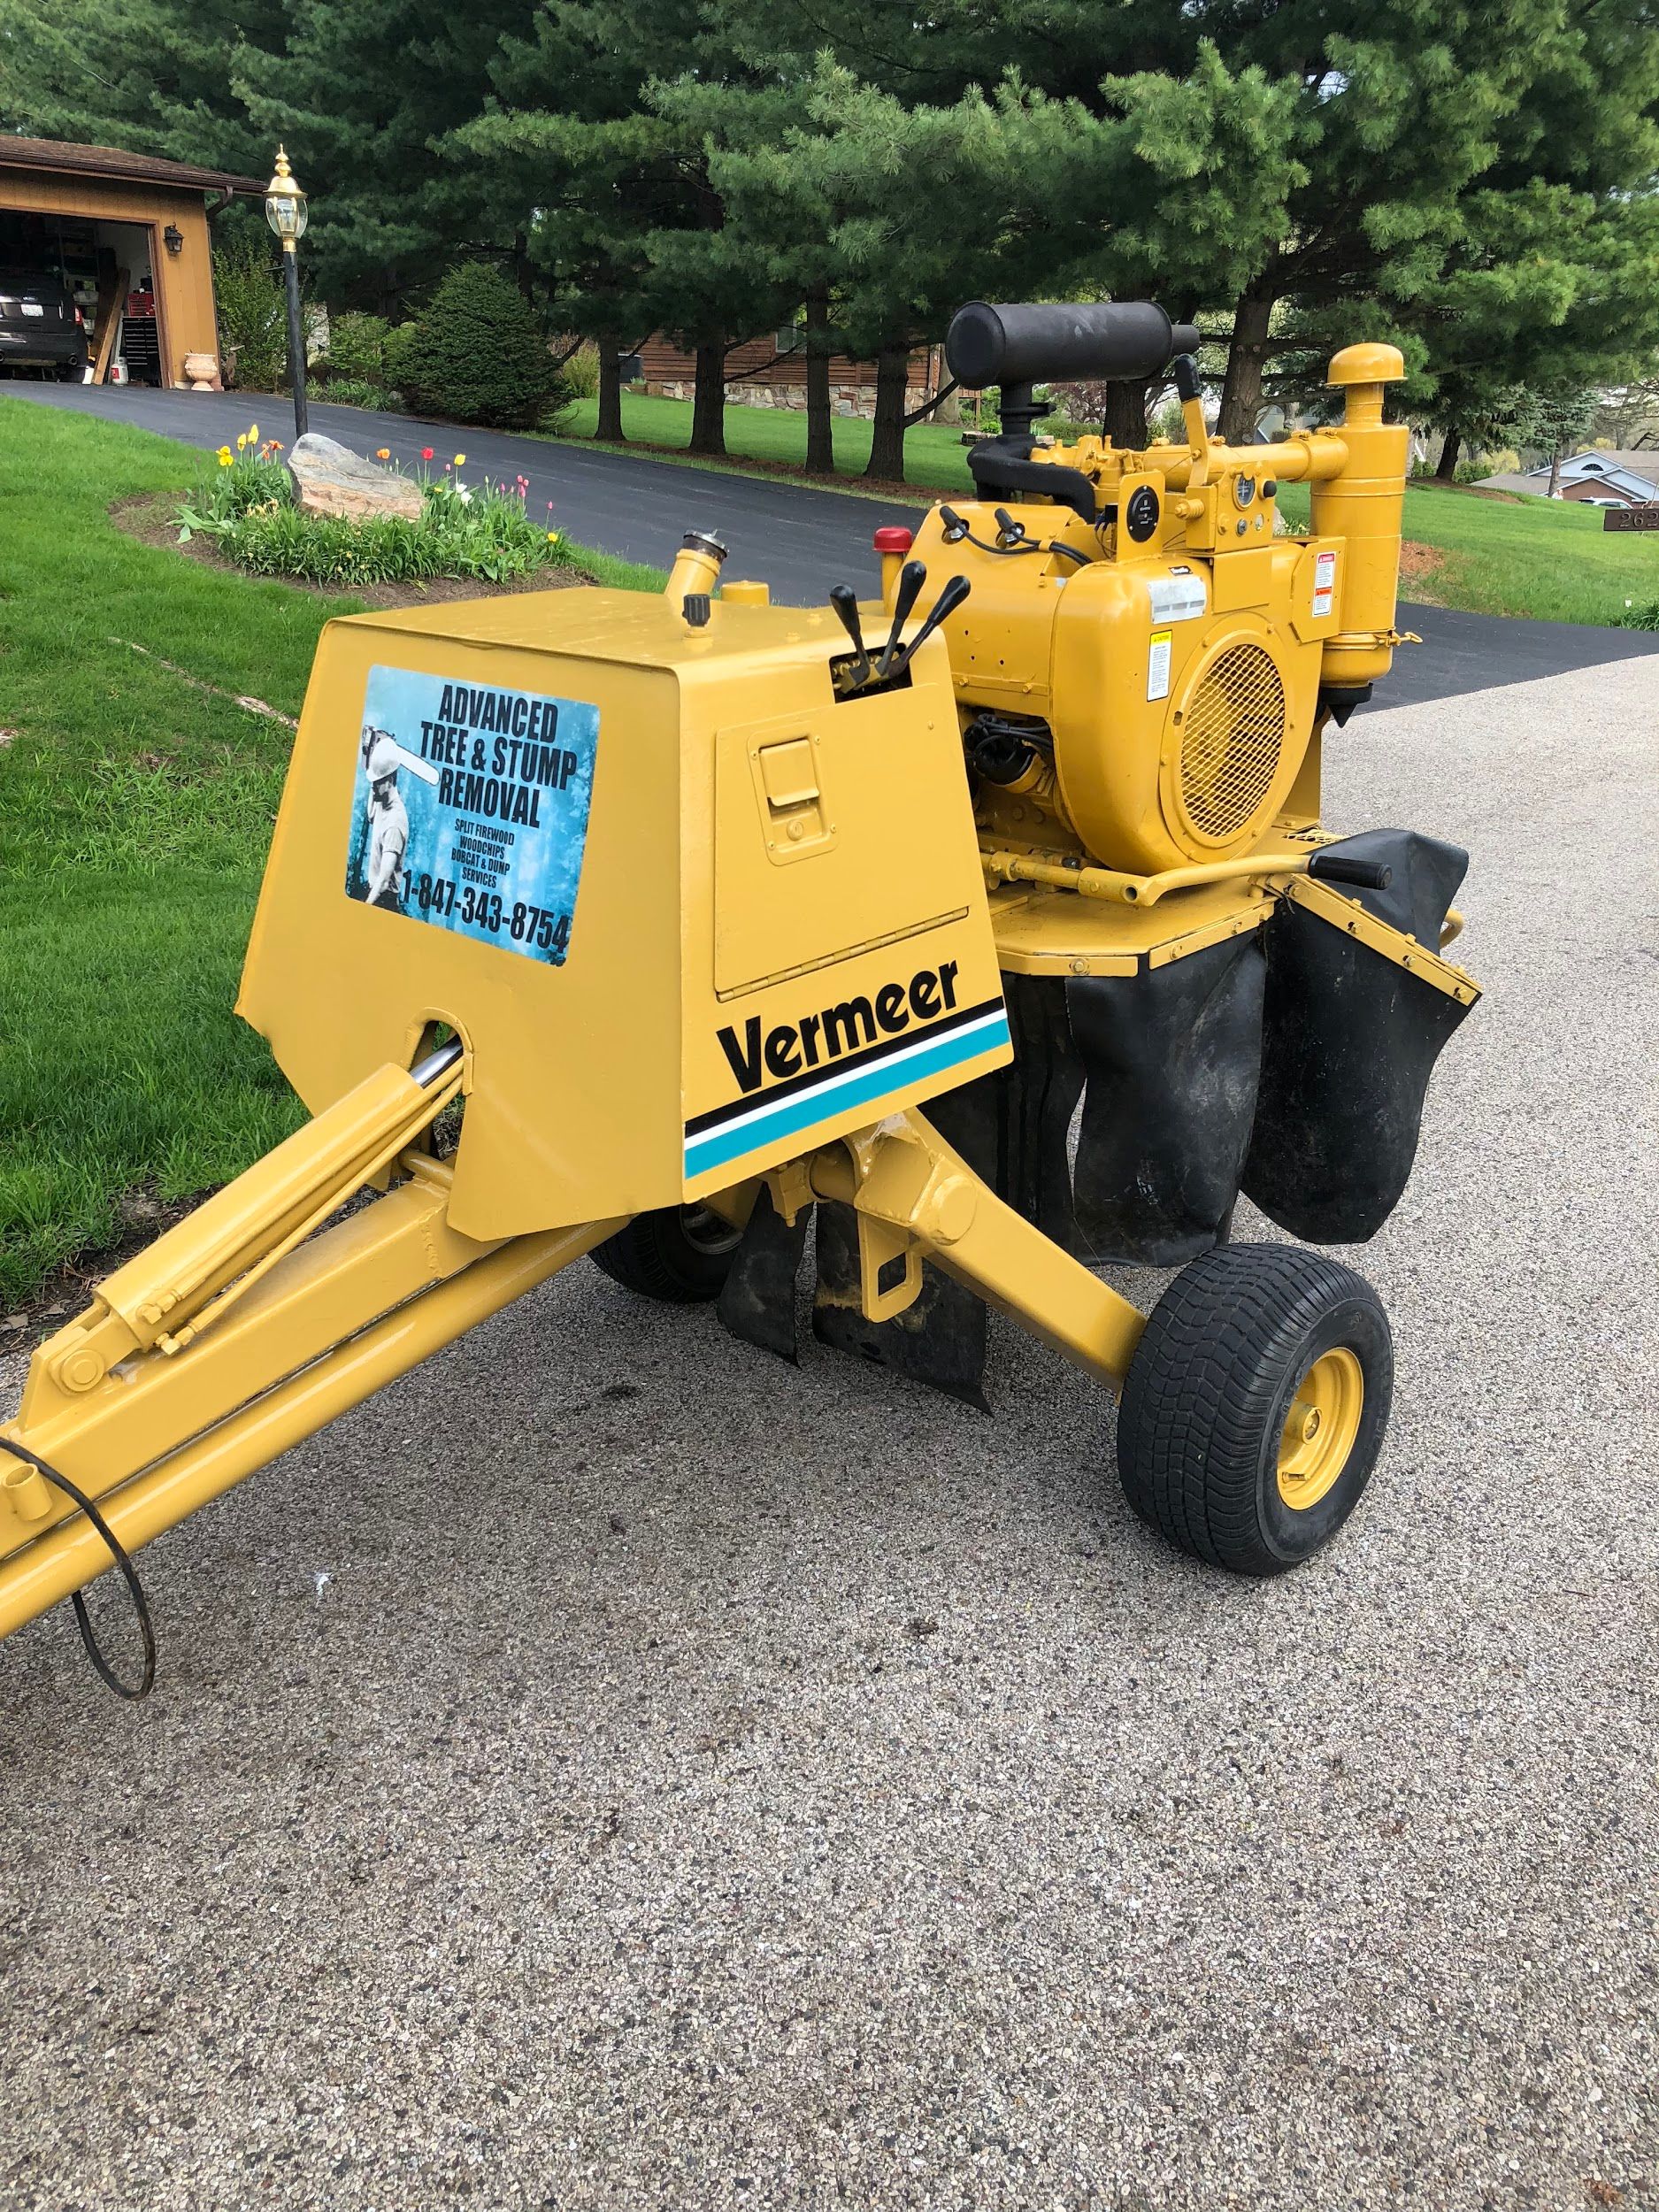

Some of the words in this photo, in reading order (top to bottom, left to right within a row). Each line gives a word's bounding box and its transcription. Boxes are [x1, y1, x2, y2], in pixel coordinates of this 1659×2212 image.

[1619, 511, 1658, 527] 262
[438, 685, 558, 744] ADVANCED
[420, 721, 469, 771] TREE
[471, 738, 487, 772] &
[492, 736, 578, 791] STUMP
[438, 769, 541, 828] REMOVAL
[454, 818, 475, 835] SPLIT
[475, 824, 515, 846] FIREWOOD
[459, 835, 505, 860] WOODCHIPS
[451, 848, 480, 867] BOBCAT
[480, 858, 487, 870] &
[488, 858, 511, 876] DUMP
[462, 867, 497, 888] SERVICES
[402, 869, 570, 954] 1-847-343-8754
[716, 959, 958, 1094] Vermeer
